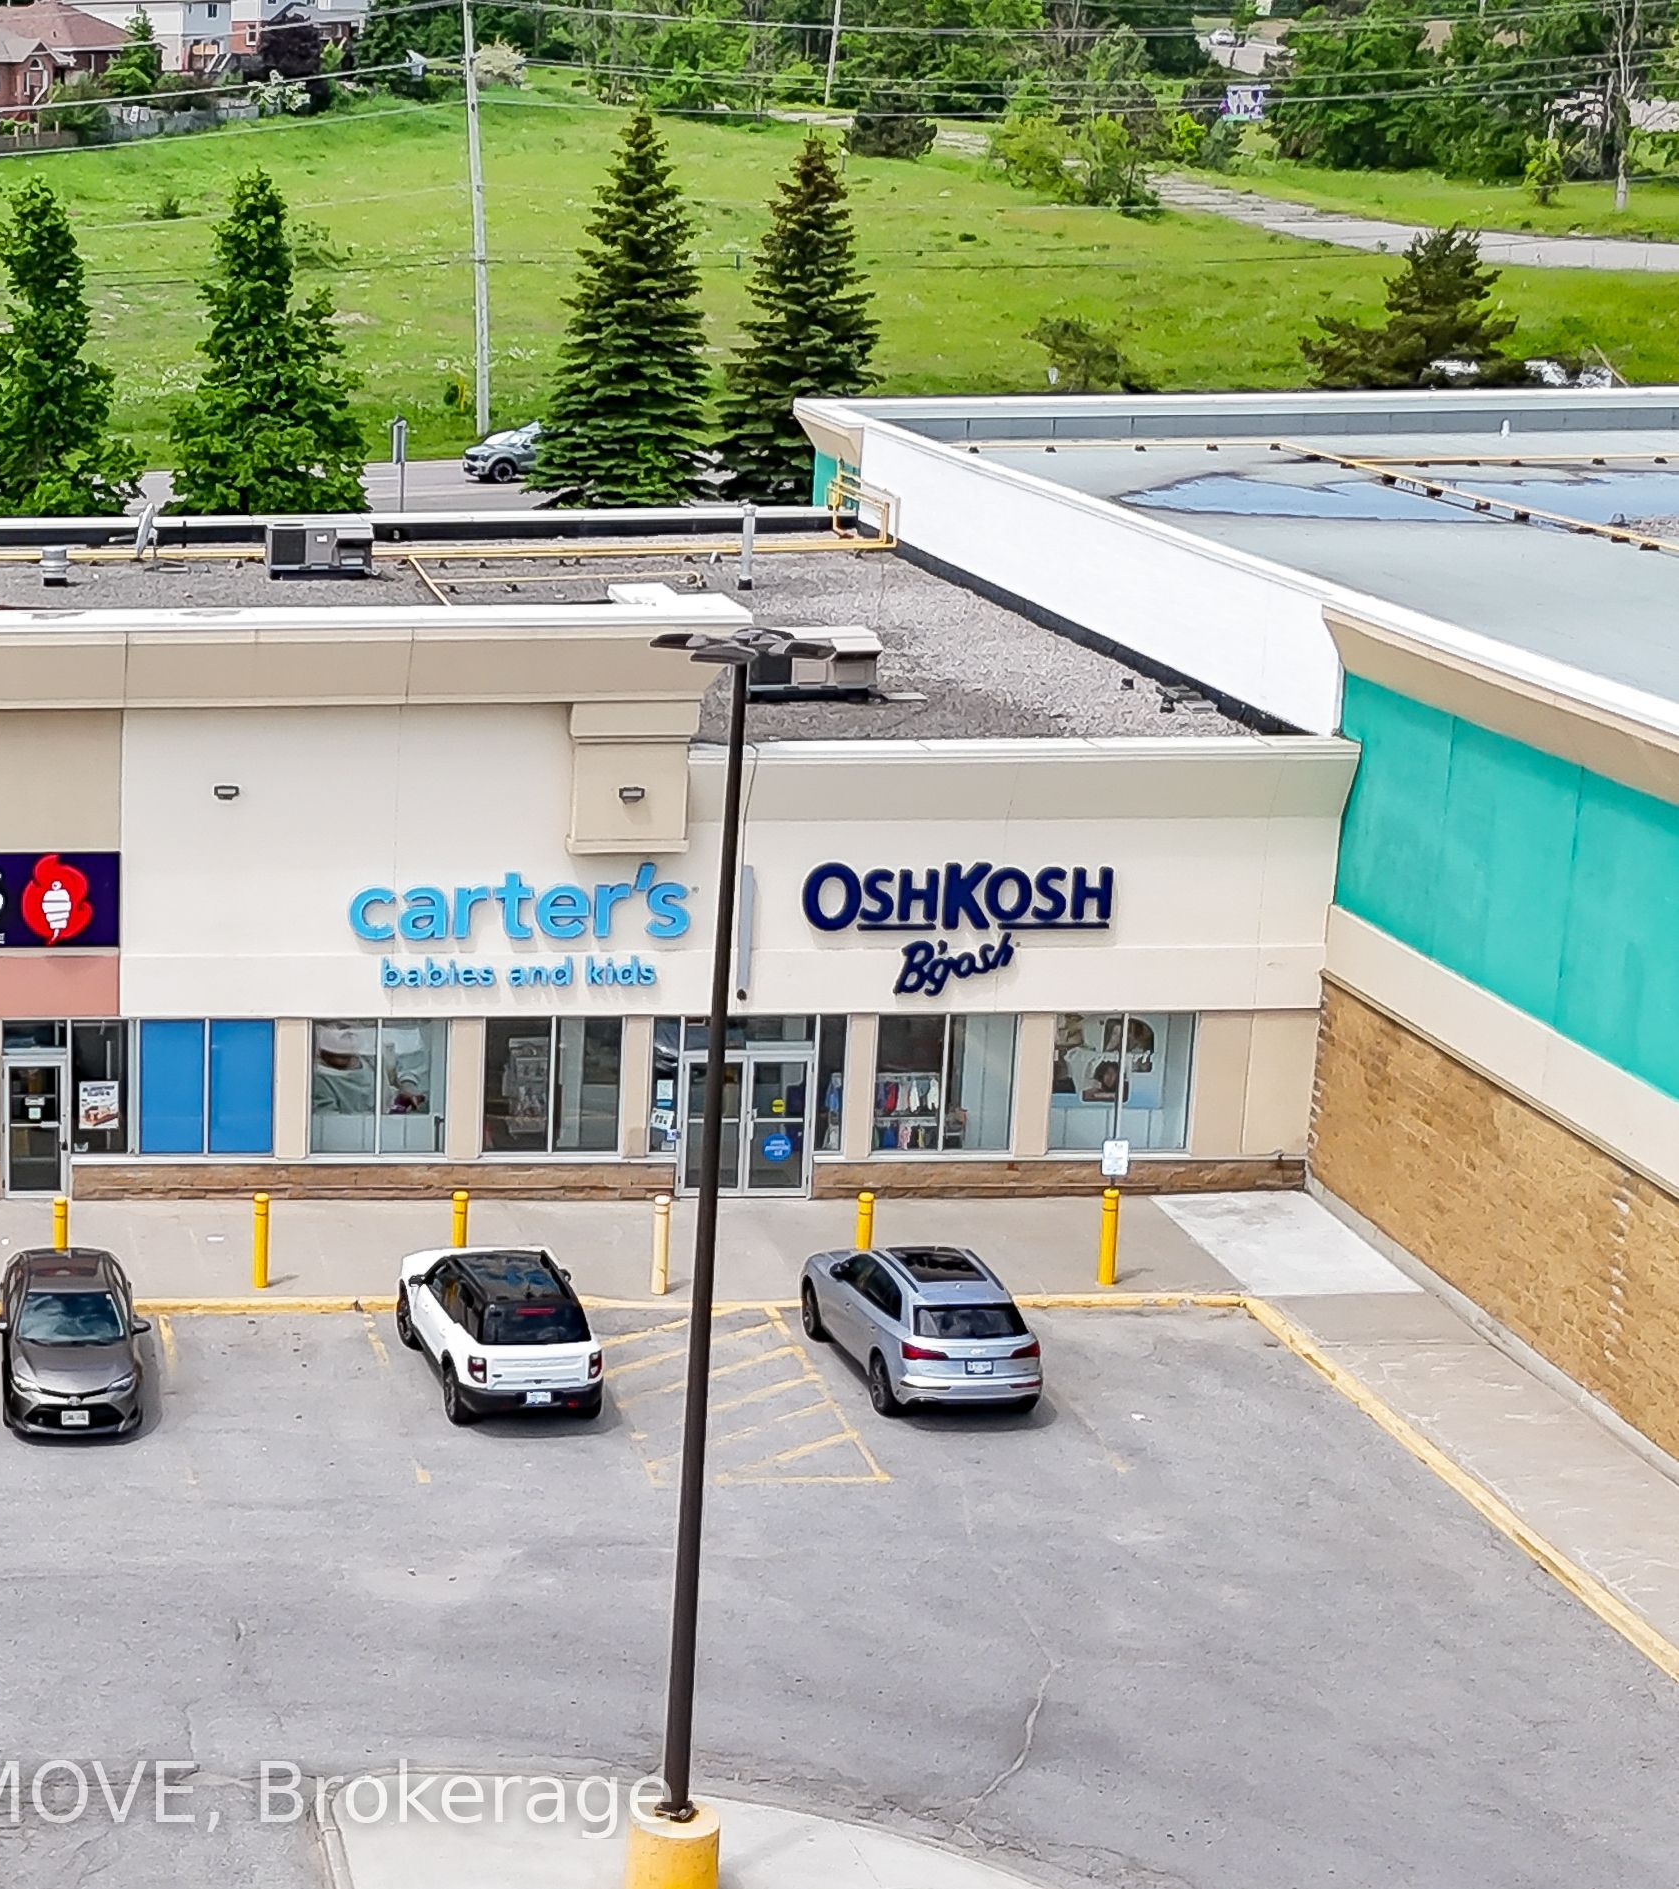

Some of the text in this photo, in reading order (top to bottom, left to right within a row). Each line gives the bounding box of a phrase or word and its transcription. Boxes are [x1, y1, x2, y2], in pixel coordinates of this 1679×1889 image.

[348, 861, 691, 941] carter's
[380, 953, 657, 989] babies and kids
[893, 931, 1016, 997] B'gosh
